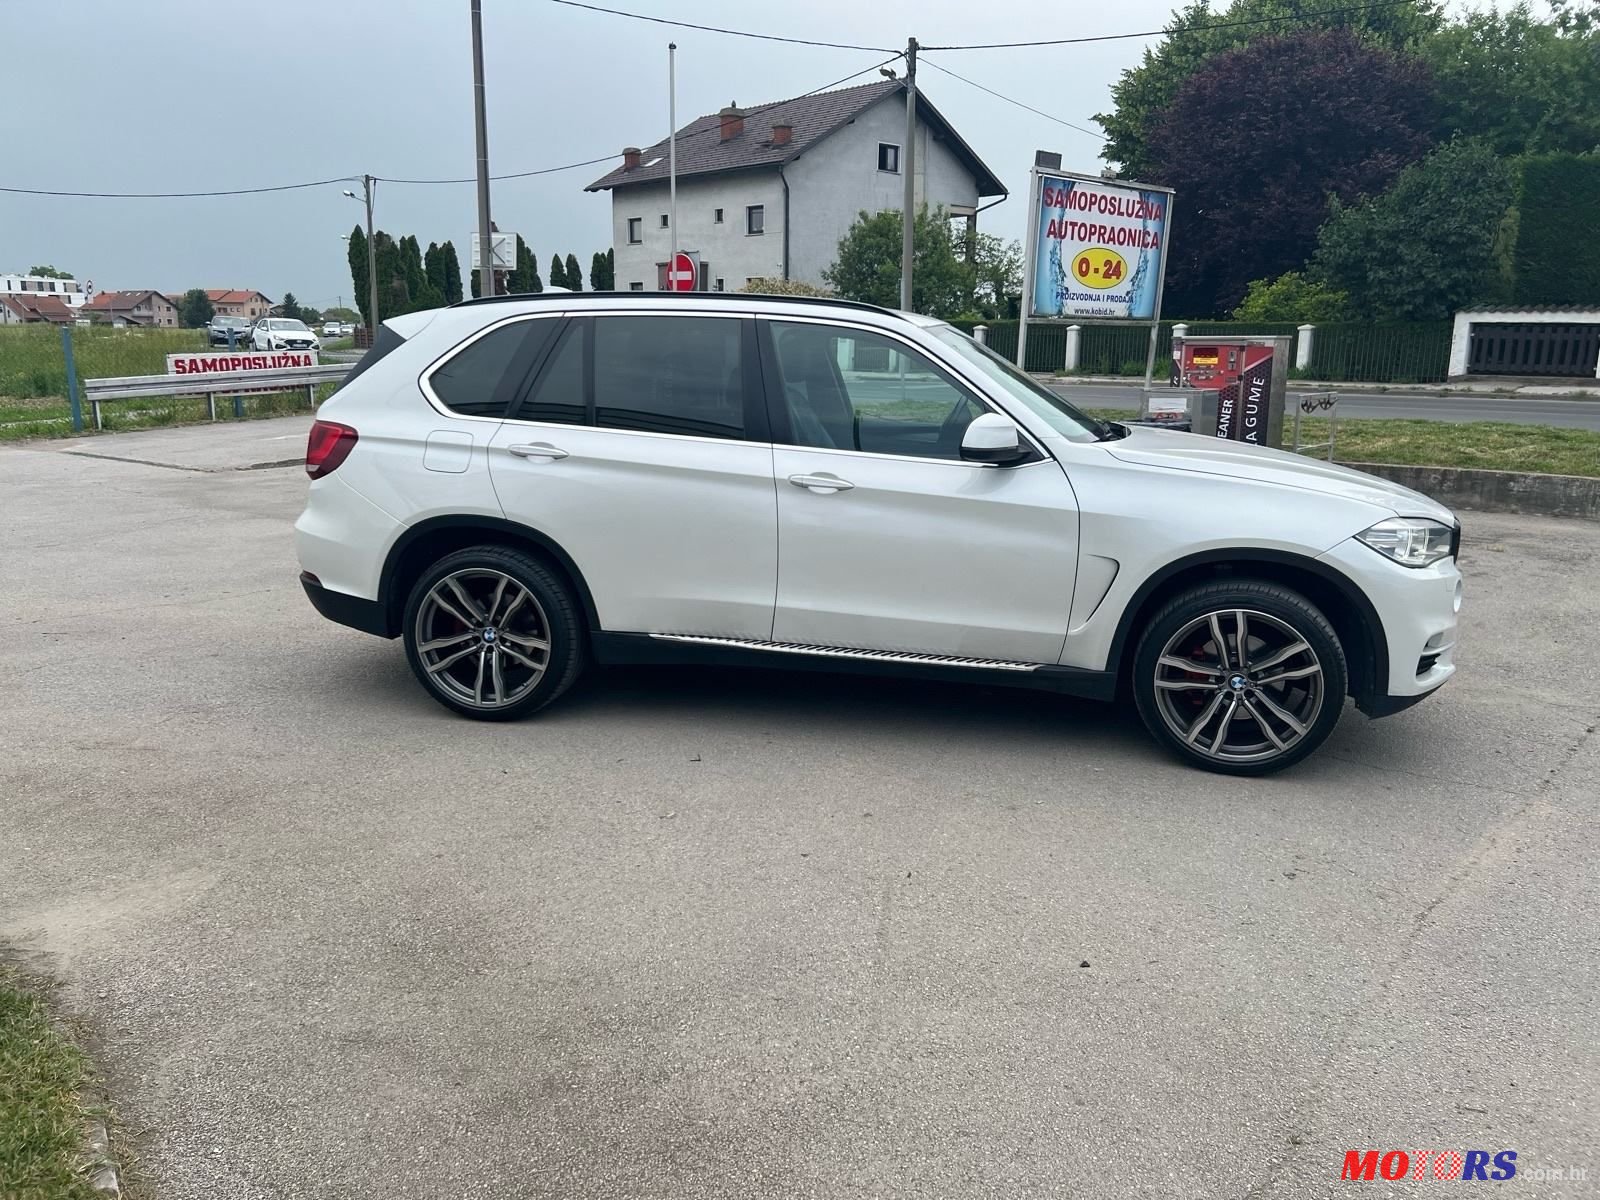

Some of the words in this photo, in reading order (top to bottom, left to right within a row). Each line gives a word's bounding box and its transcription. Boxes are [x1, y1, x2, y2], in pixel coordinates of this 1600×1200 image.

[1047, 219, 1159, 249] AUTOPRAONICA
[1102, 259, 1122, 279] 24
[1056, 292, 1100, 302] PROIZVODNJA
[1106, 296, 1134, 304] PRODAJA
[1074, 307, 1116, 316] www.kobid.hr
[174, 352, 312, 374] SAMOPOSLUŽNA
[1245, 377, 1265, 427] GUME
